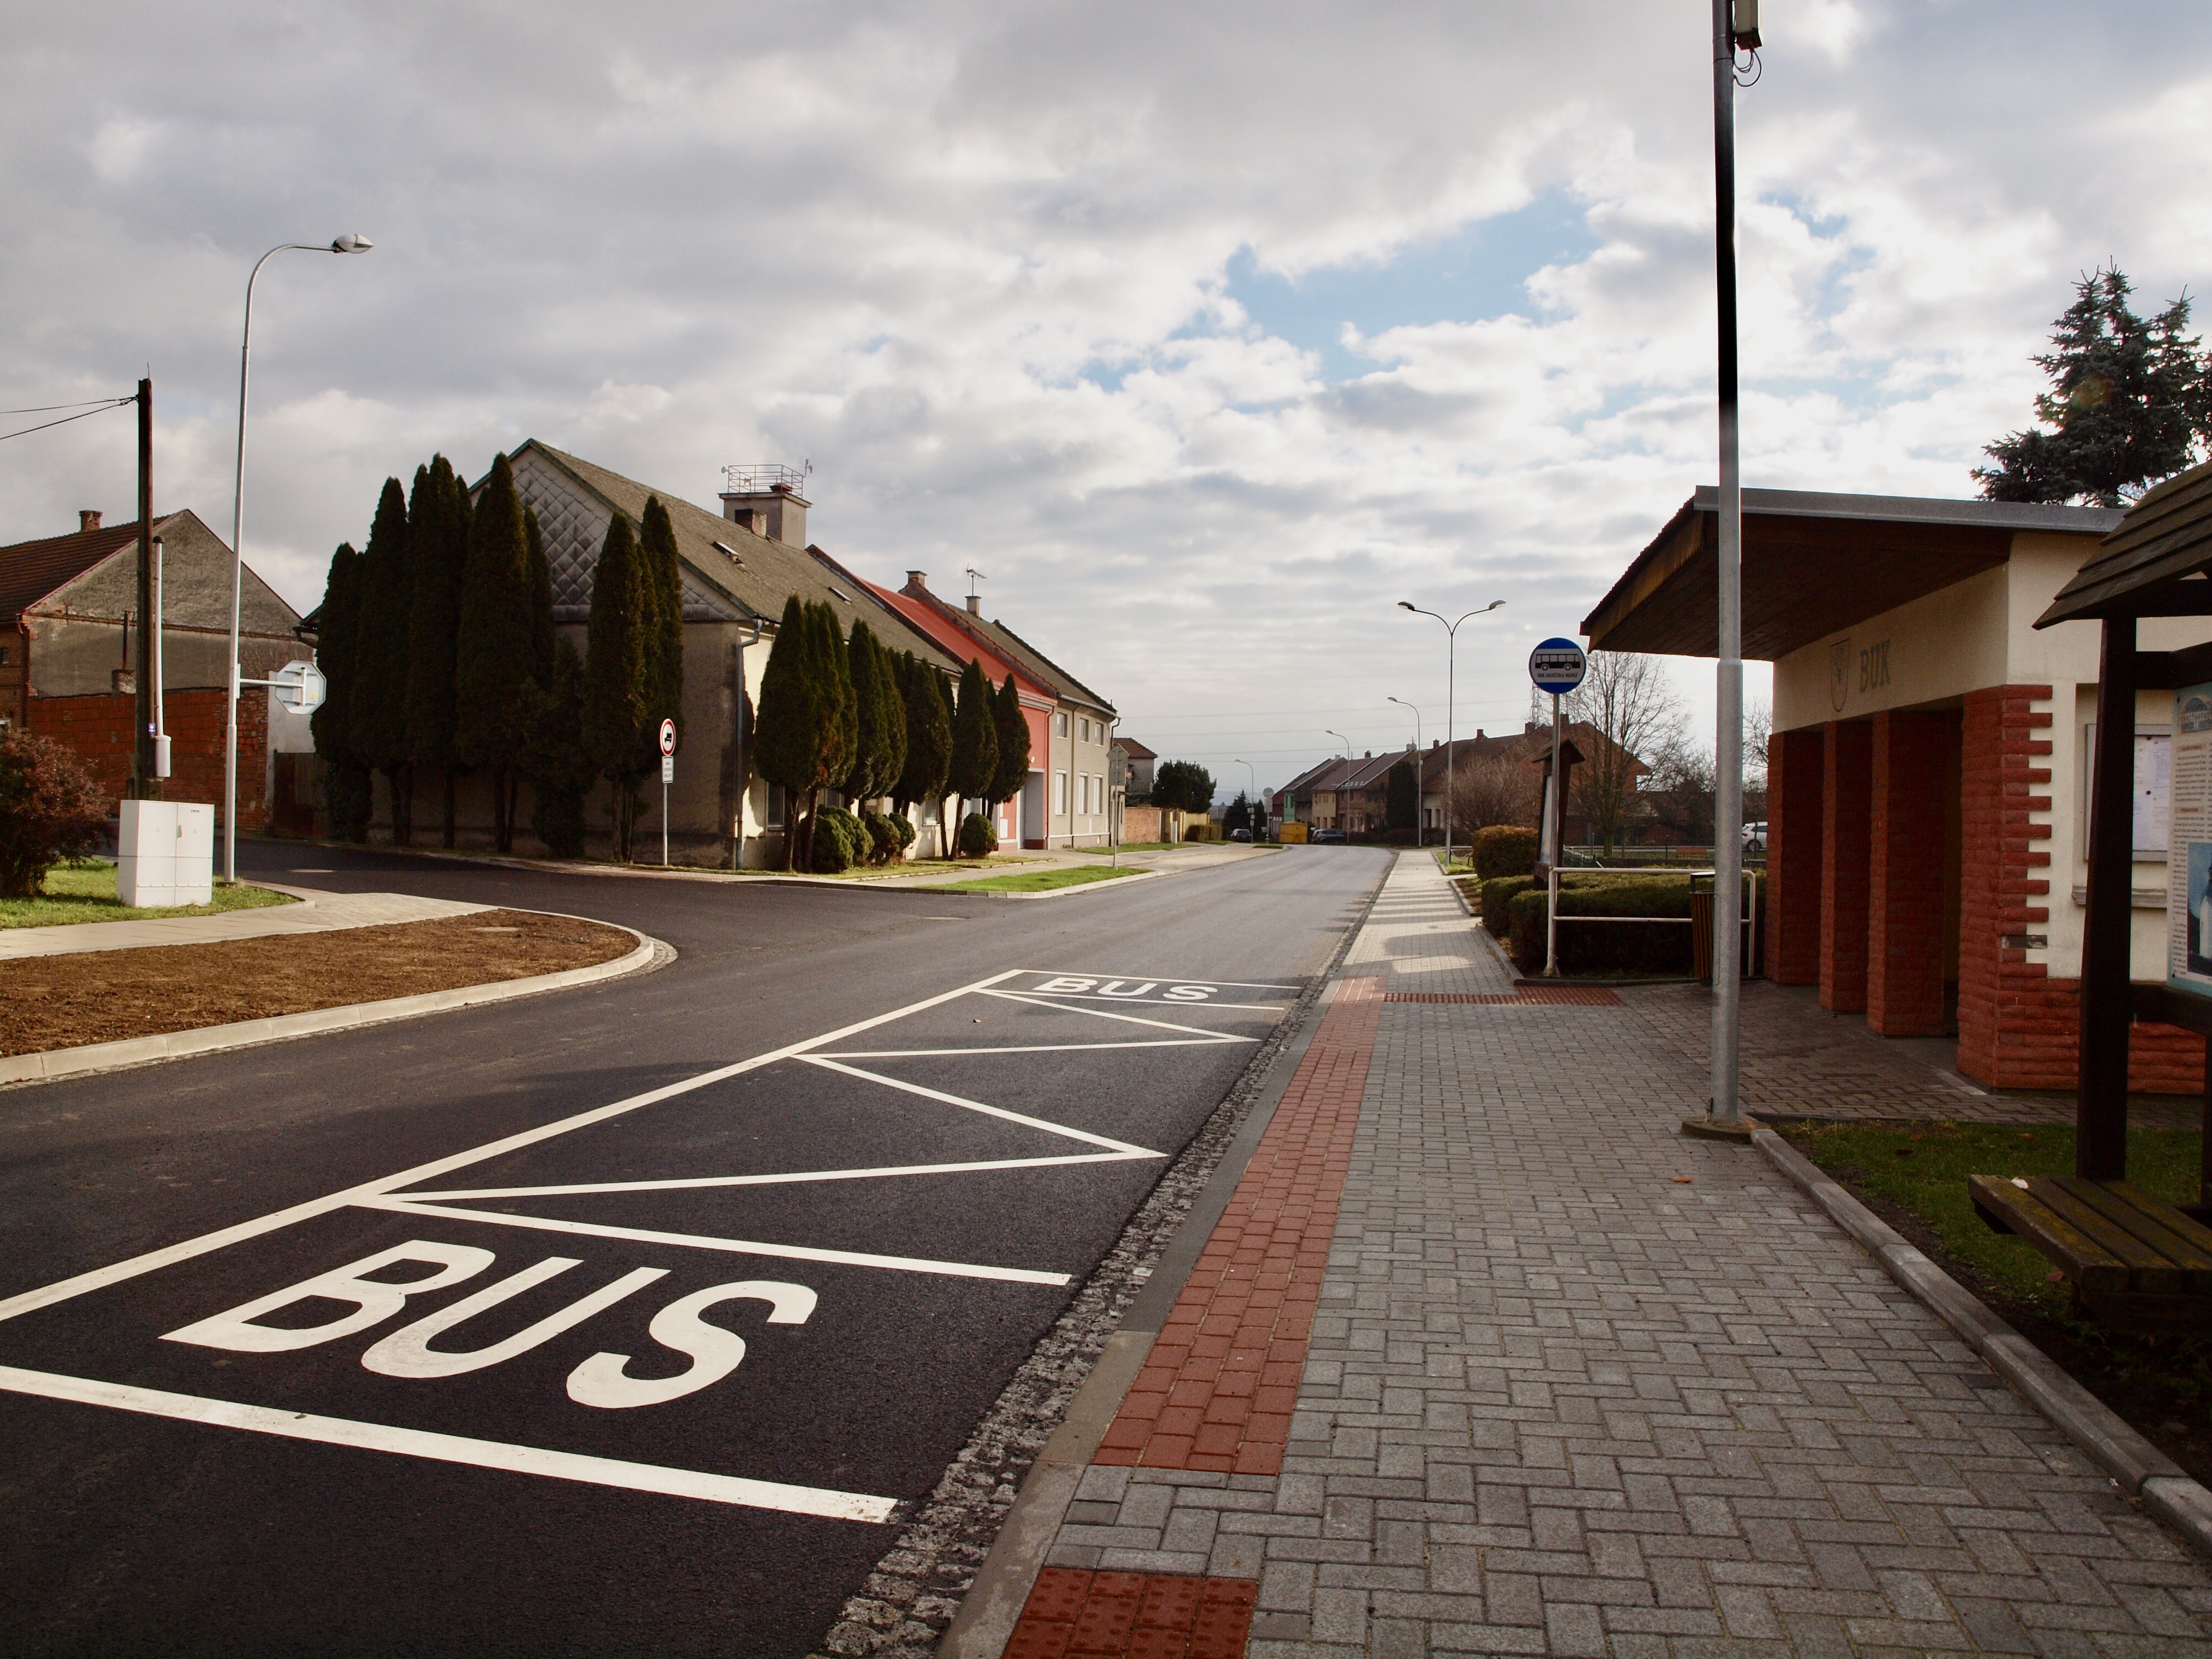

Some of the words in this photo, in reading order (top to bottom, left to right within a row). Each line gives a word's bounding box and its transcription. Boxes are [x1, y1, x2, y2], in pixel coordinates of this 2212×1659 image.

[1860, 640, 1891, 692] BUK
[1032, 977, 1218, 1000] BUS
[158, 1239, 818, 1408] BUS
